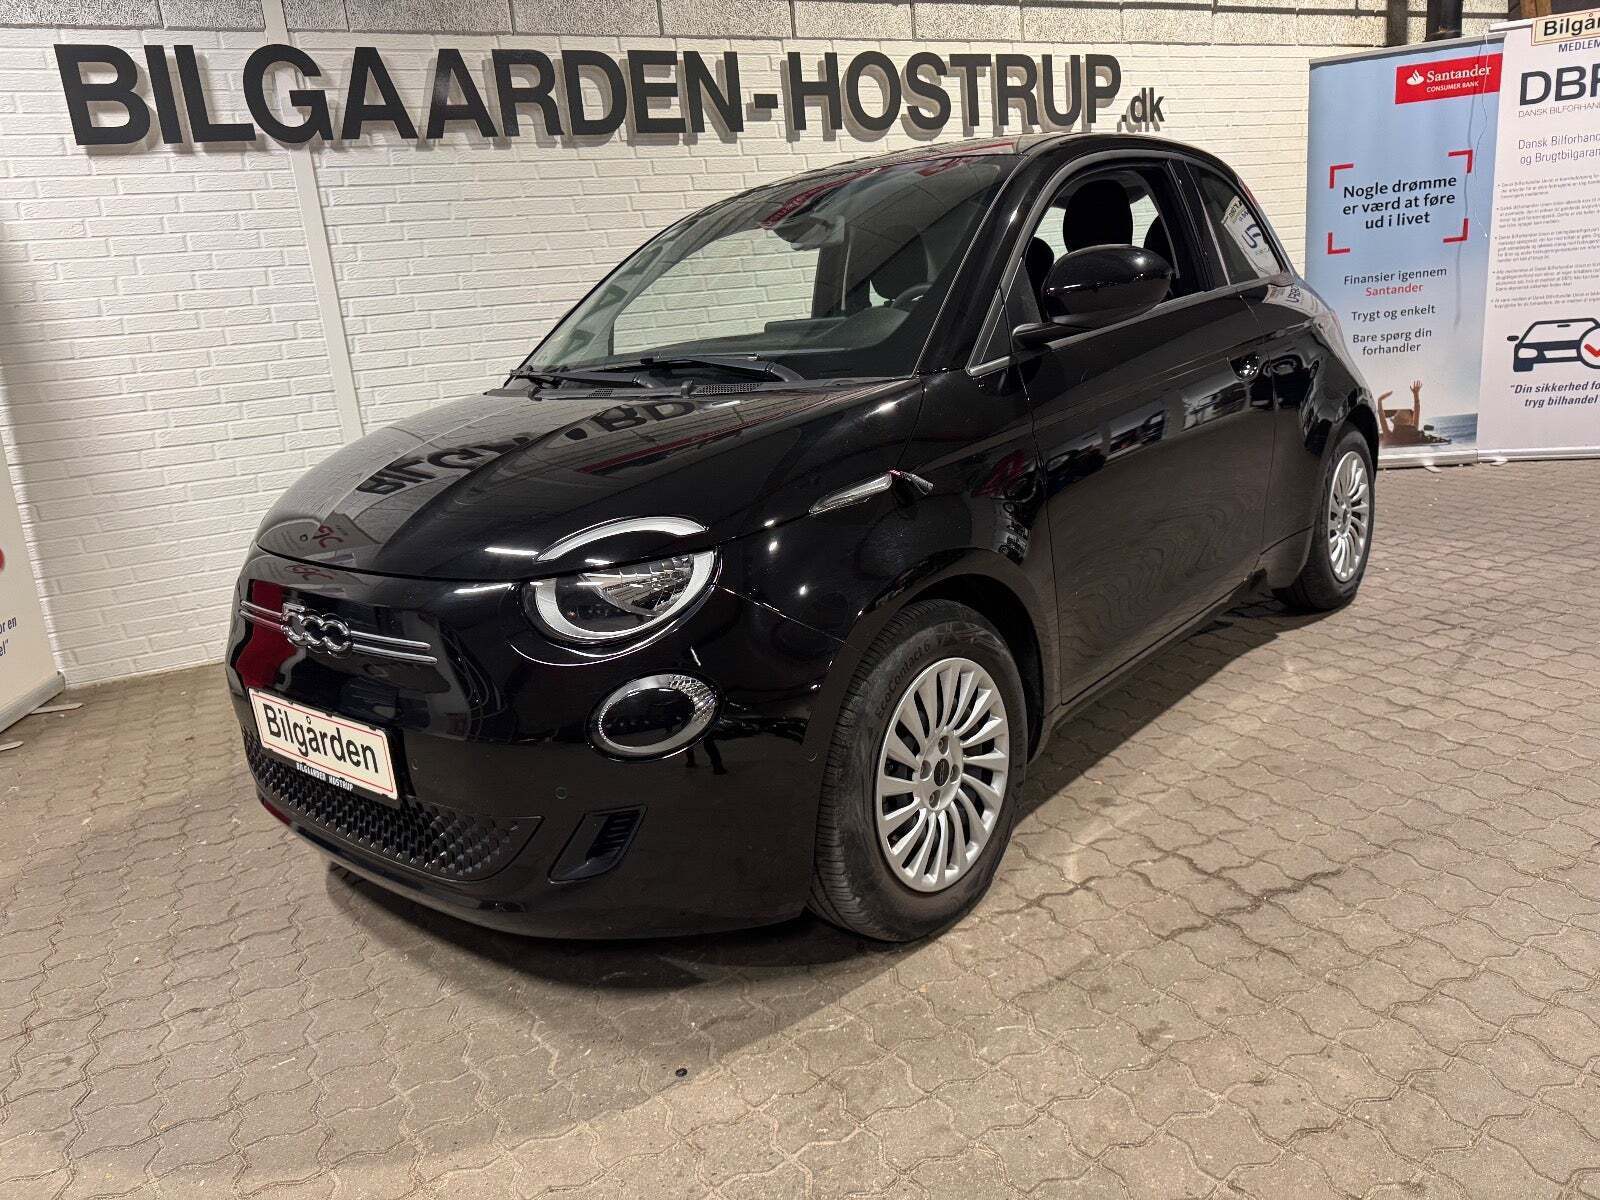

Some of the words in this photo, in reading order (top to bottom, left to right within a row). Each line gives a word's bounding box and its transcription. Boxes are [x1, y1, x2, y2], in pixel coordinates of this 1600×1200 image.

[1426, 64, 1492, 83] Santander
[1426, 83, 1461, 93] CONSUMER
[1461, 80, 1479, 89] BANK
[1518, 108, 1548, 118] DANSK
[1518, 138, 1548, 150] Dansk
[1520, 155, 1532, 166] og
[1343, 181, 1389, 200] Nogle
[1392, 176, 1457, 193] drømme
[1342, 204, 1359, 215] er
[1362, 196, 1401, 213] værd
[1404, 196, 1420, 209] at
[1424, 193, 1456, 207] føre
[1365, 215, 1384, 229] ud
[1388, 214, 1393, 227] i
[1397, 211, 1431, 226] livet
[1344, 272, 1396, 285] Finansier
[1398, 268, 1447, 282] igennem
[1365, 283, 1424, 297] Santander
[1351, 309, 1381, 322] Trygt
[1383, 309, 1398, 320] og
[1400, 304, 1436, 317] enkelt
[1352, 334, 1378, 343] Bare
[1380, 331, 1412, 342] spørg
[1414, 327, 1432, 339] din
[1362, 342, 1422, 356] forhandler
[1535, 381, 1589, 393] sikkerhed
[1524, 398, 1545, 409] tryg
[1547, 394, 1599, 406] bilhandel
[7, 616, 17, 630] en
[282, 602, 351, 652] 500
[263, 703, 379, 774] Bilgården
